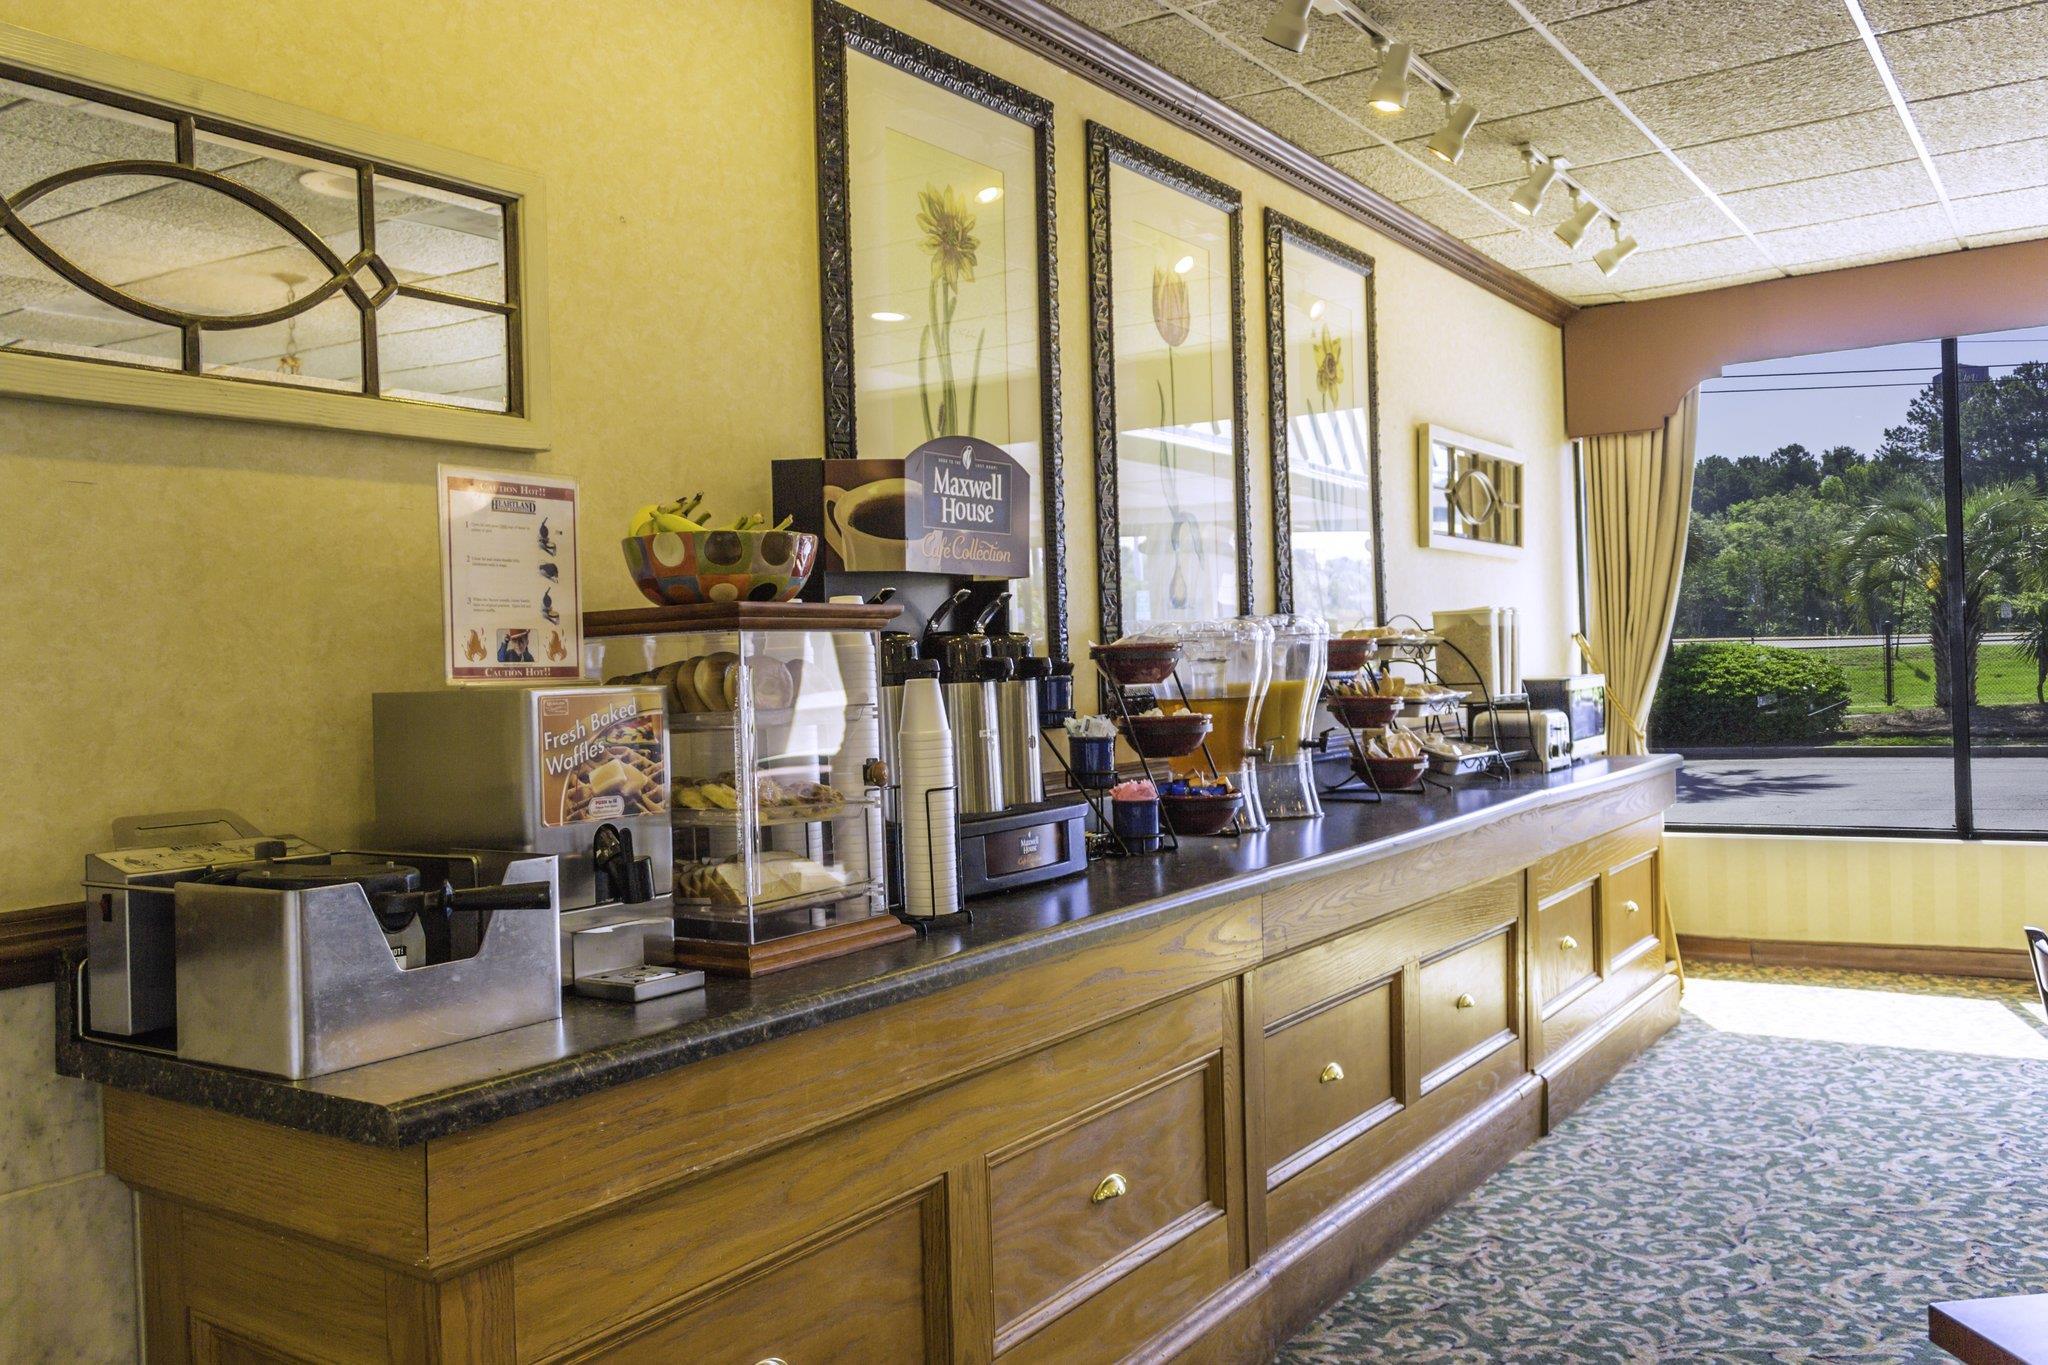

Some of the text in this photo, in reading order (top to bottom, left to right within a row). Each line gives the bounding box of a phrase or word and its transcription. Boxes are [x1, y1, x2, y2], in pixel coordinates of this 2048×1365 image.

[933, 466, 1002, 501] Maxwell
[492, 499, 537, 513] HEARTLAND
[941, 496, 994, 524] House
[922, 532, 1012, 566] Café Collection
[484, 667, 551, 677] CAUTION HOT!!
[544, 719, 586, 751] Fresh
[591, 696, 637, 732] Baked
[546, 740, 605, 776] Waffles
[392, 947, 404, 956] OT!
